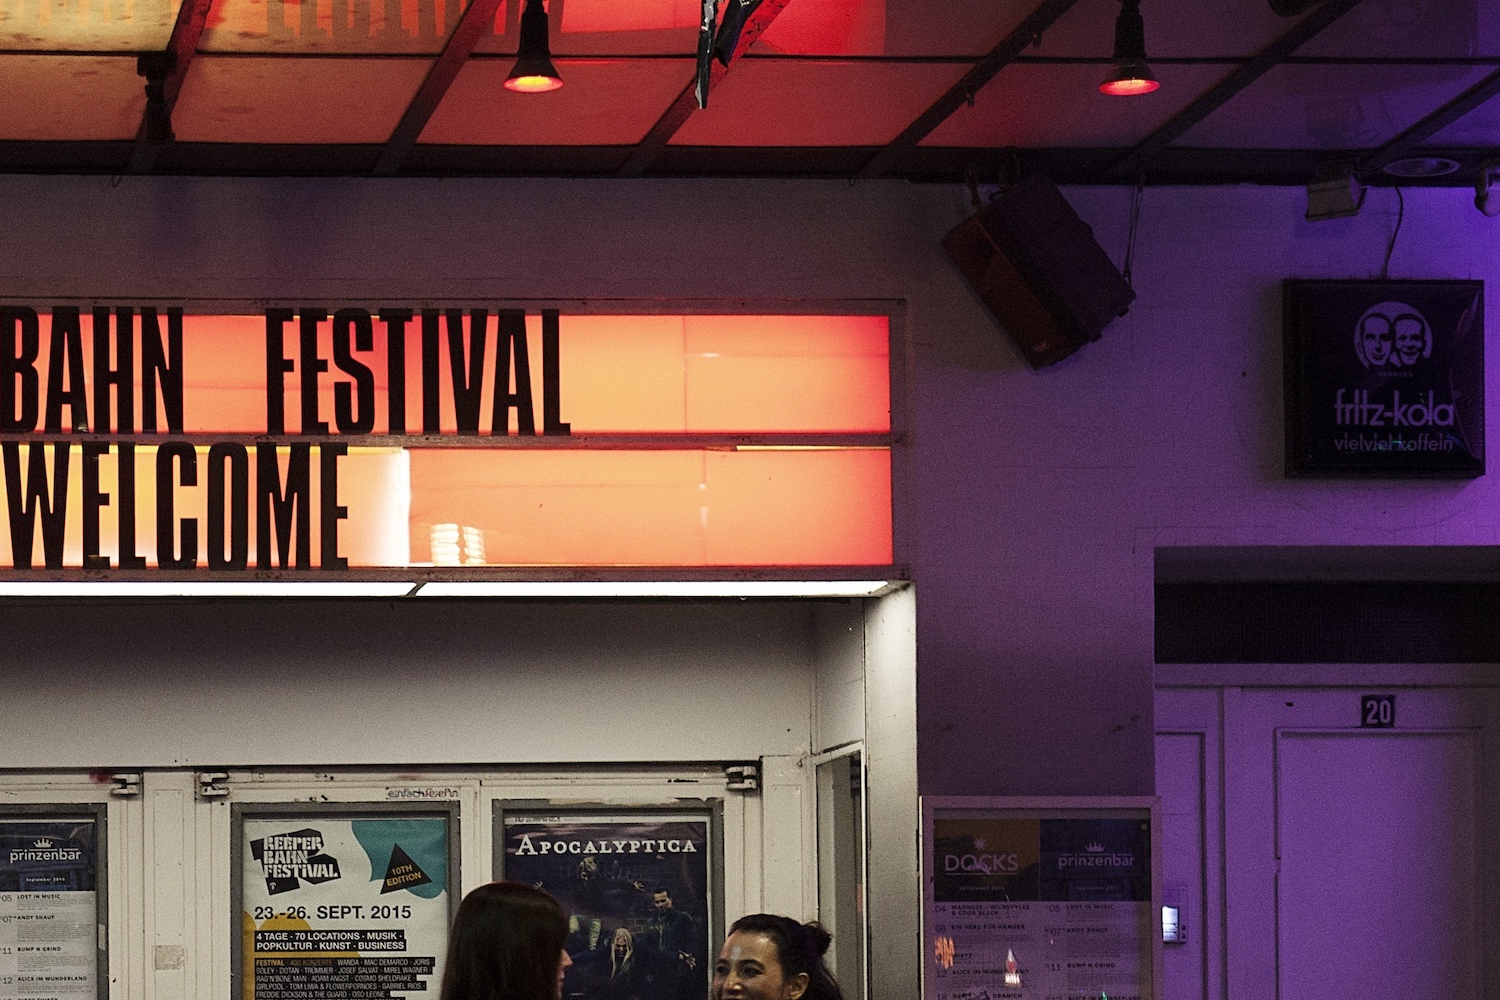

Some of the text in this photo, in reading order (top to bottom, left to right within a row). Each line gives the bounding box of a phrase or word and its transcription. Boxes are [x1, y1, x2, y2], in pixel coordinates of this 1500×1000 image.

[266, 308, 571, 435] FESTIVAL
[1334, 388, 1454, 426] fritz-kola
[4, 441, 348, 569] WELCOME
[1366, 700, 1391, 724] 20
[263, 836, 321, 851] REEPER
[10, 850, 81, 863] prinzenbar
[263, 851, 308, 864] BAHN
[945, 854, 1135, 871] DOCKS prinzenbar
[392, 864, 413, 875] 10TH
[387, 872, 422, 887] EDITION
[255, 905, 411, 920] 23.-26. SEPT. 2015
[257, 941, 404, 950] POPKULTUR KUNST BUSINESS
